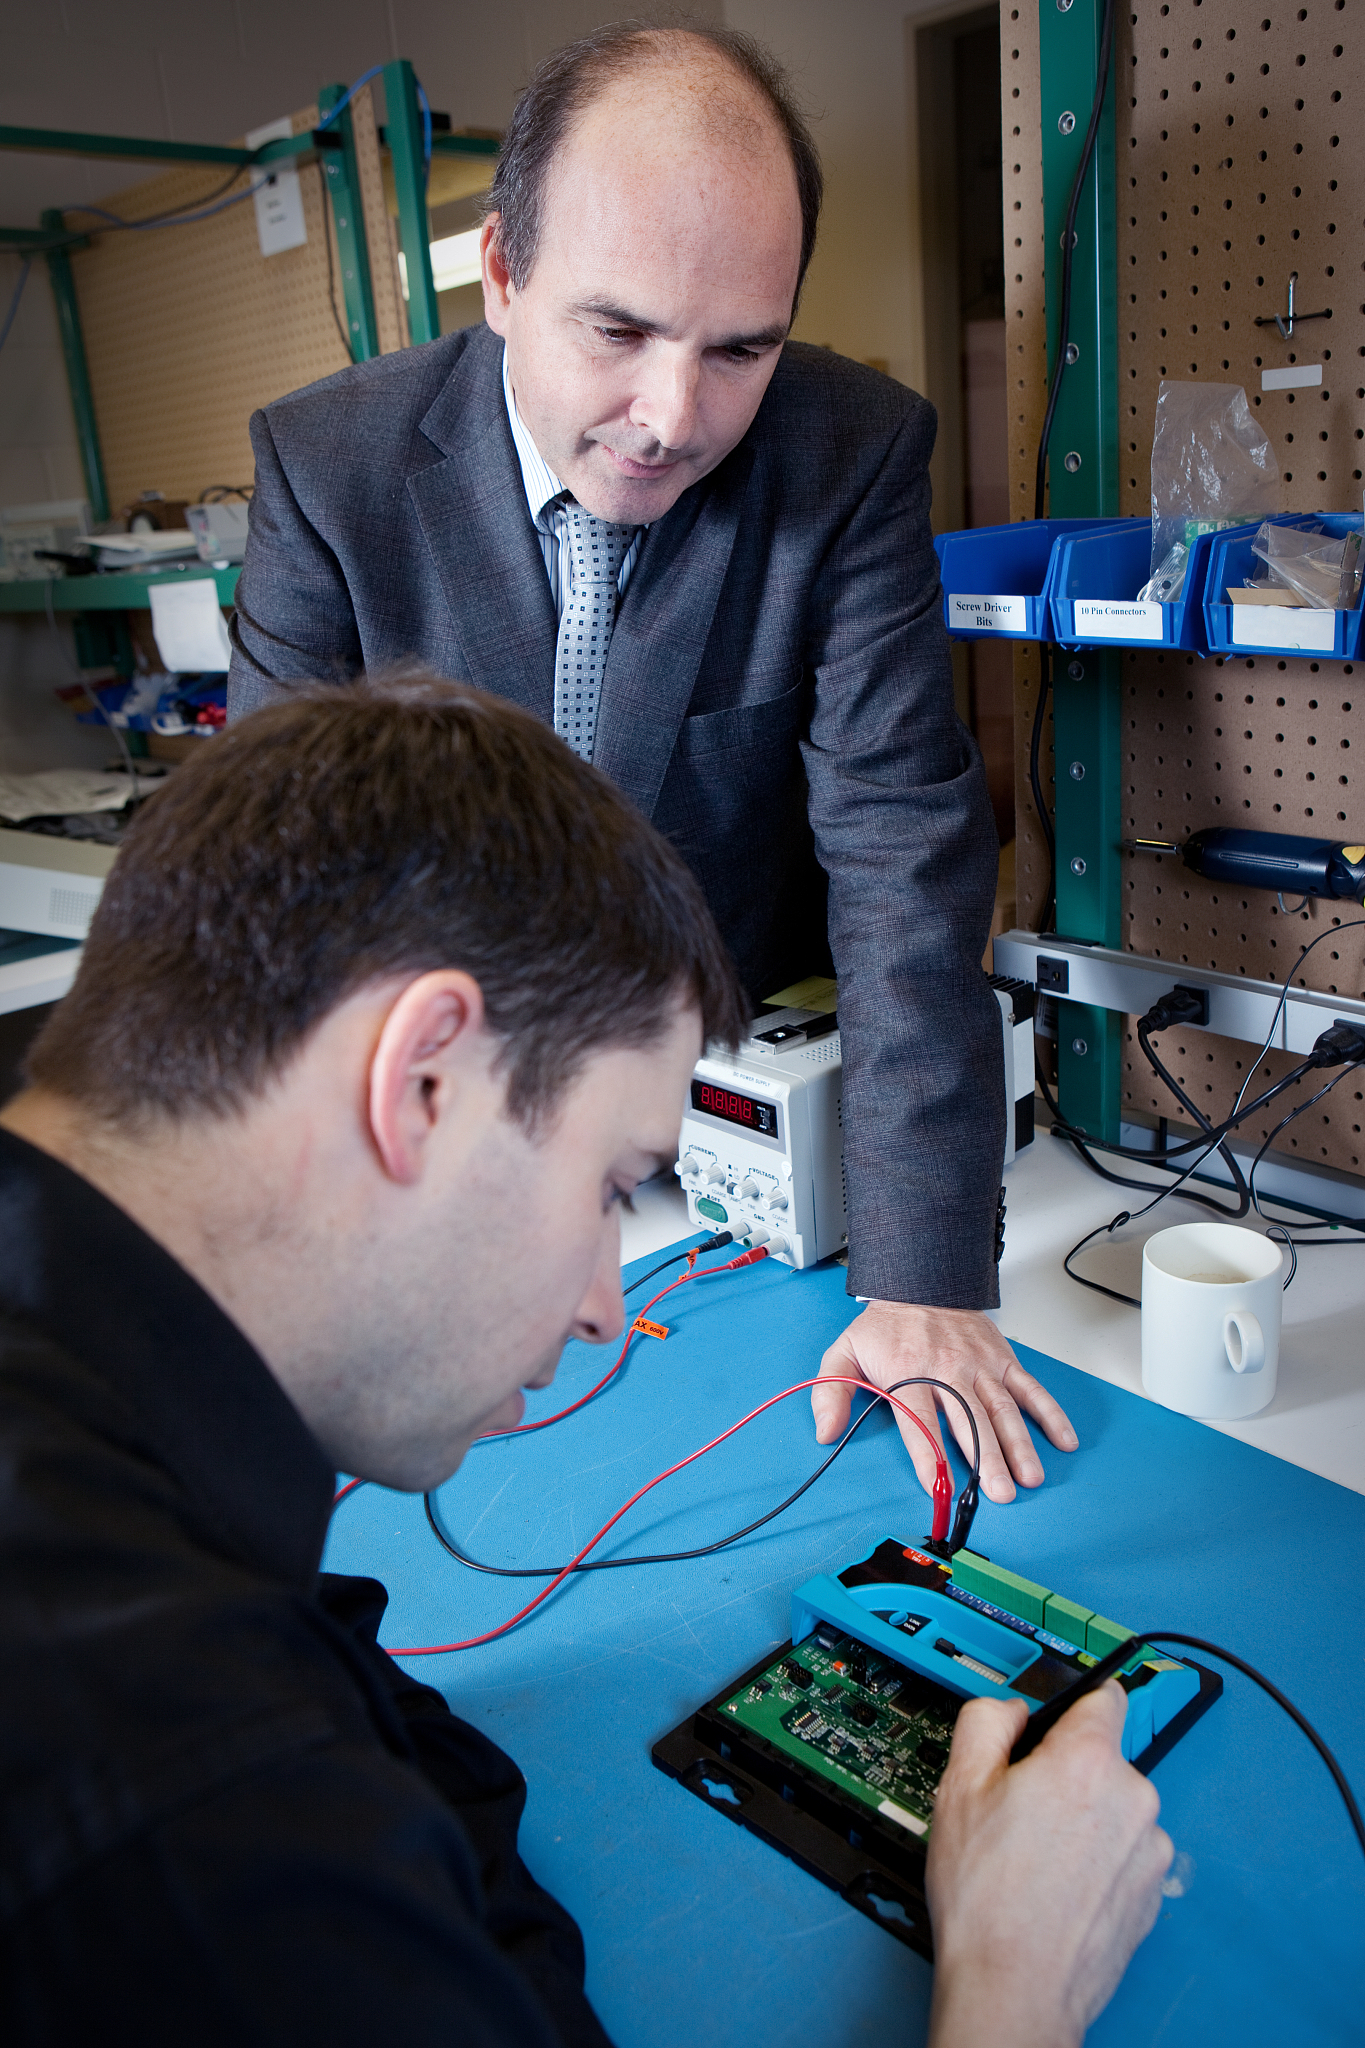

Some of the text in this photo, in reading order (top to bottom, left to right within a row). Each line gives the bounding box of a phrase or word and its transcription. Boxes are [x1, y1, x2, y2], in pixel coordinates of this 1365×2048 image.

[956, 600, 1012, 613] Screw Driver
[1080, 606, 1147, 616] 10 Pin Connectors
[976, 616, 993, 627] Bits
[740, 1073, 754, 1082] POWER
[755, 1078, 771, 1087] SUPPLY
[690, 1144, 715, 1156] CURRENT
[751, 1168, 776, 1181] VOLTAGE
[753, 1213, 766, 1222] GND
[635, 1320, 647, 1329] AX
